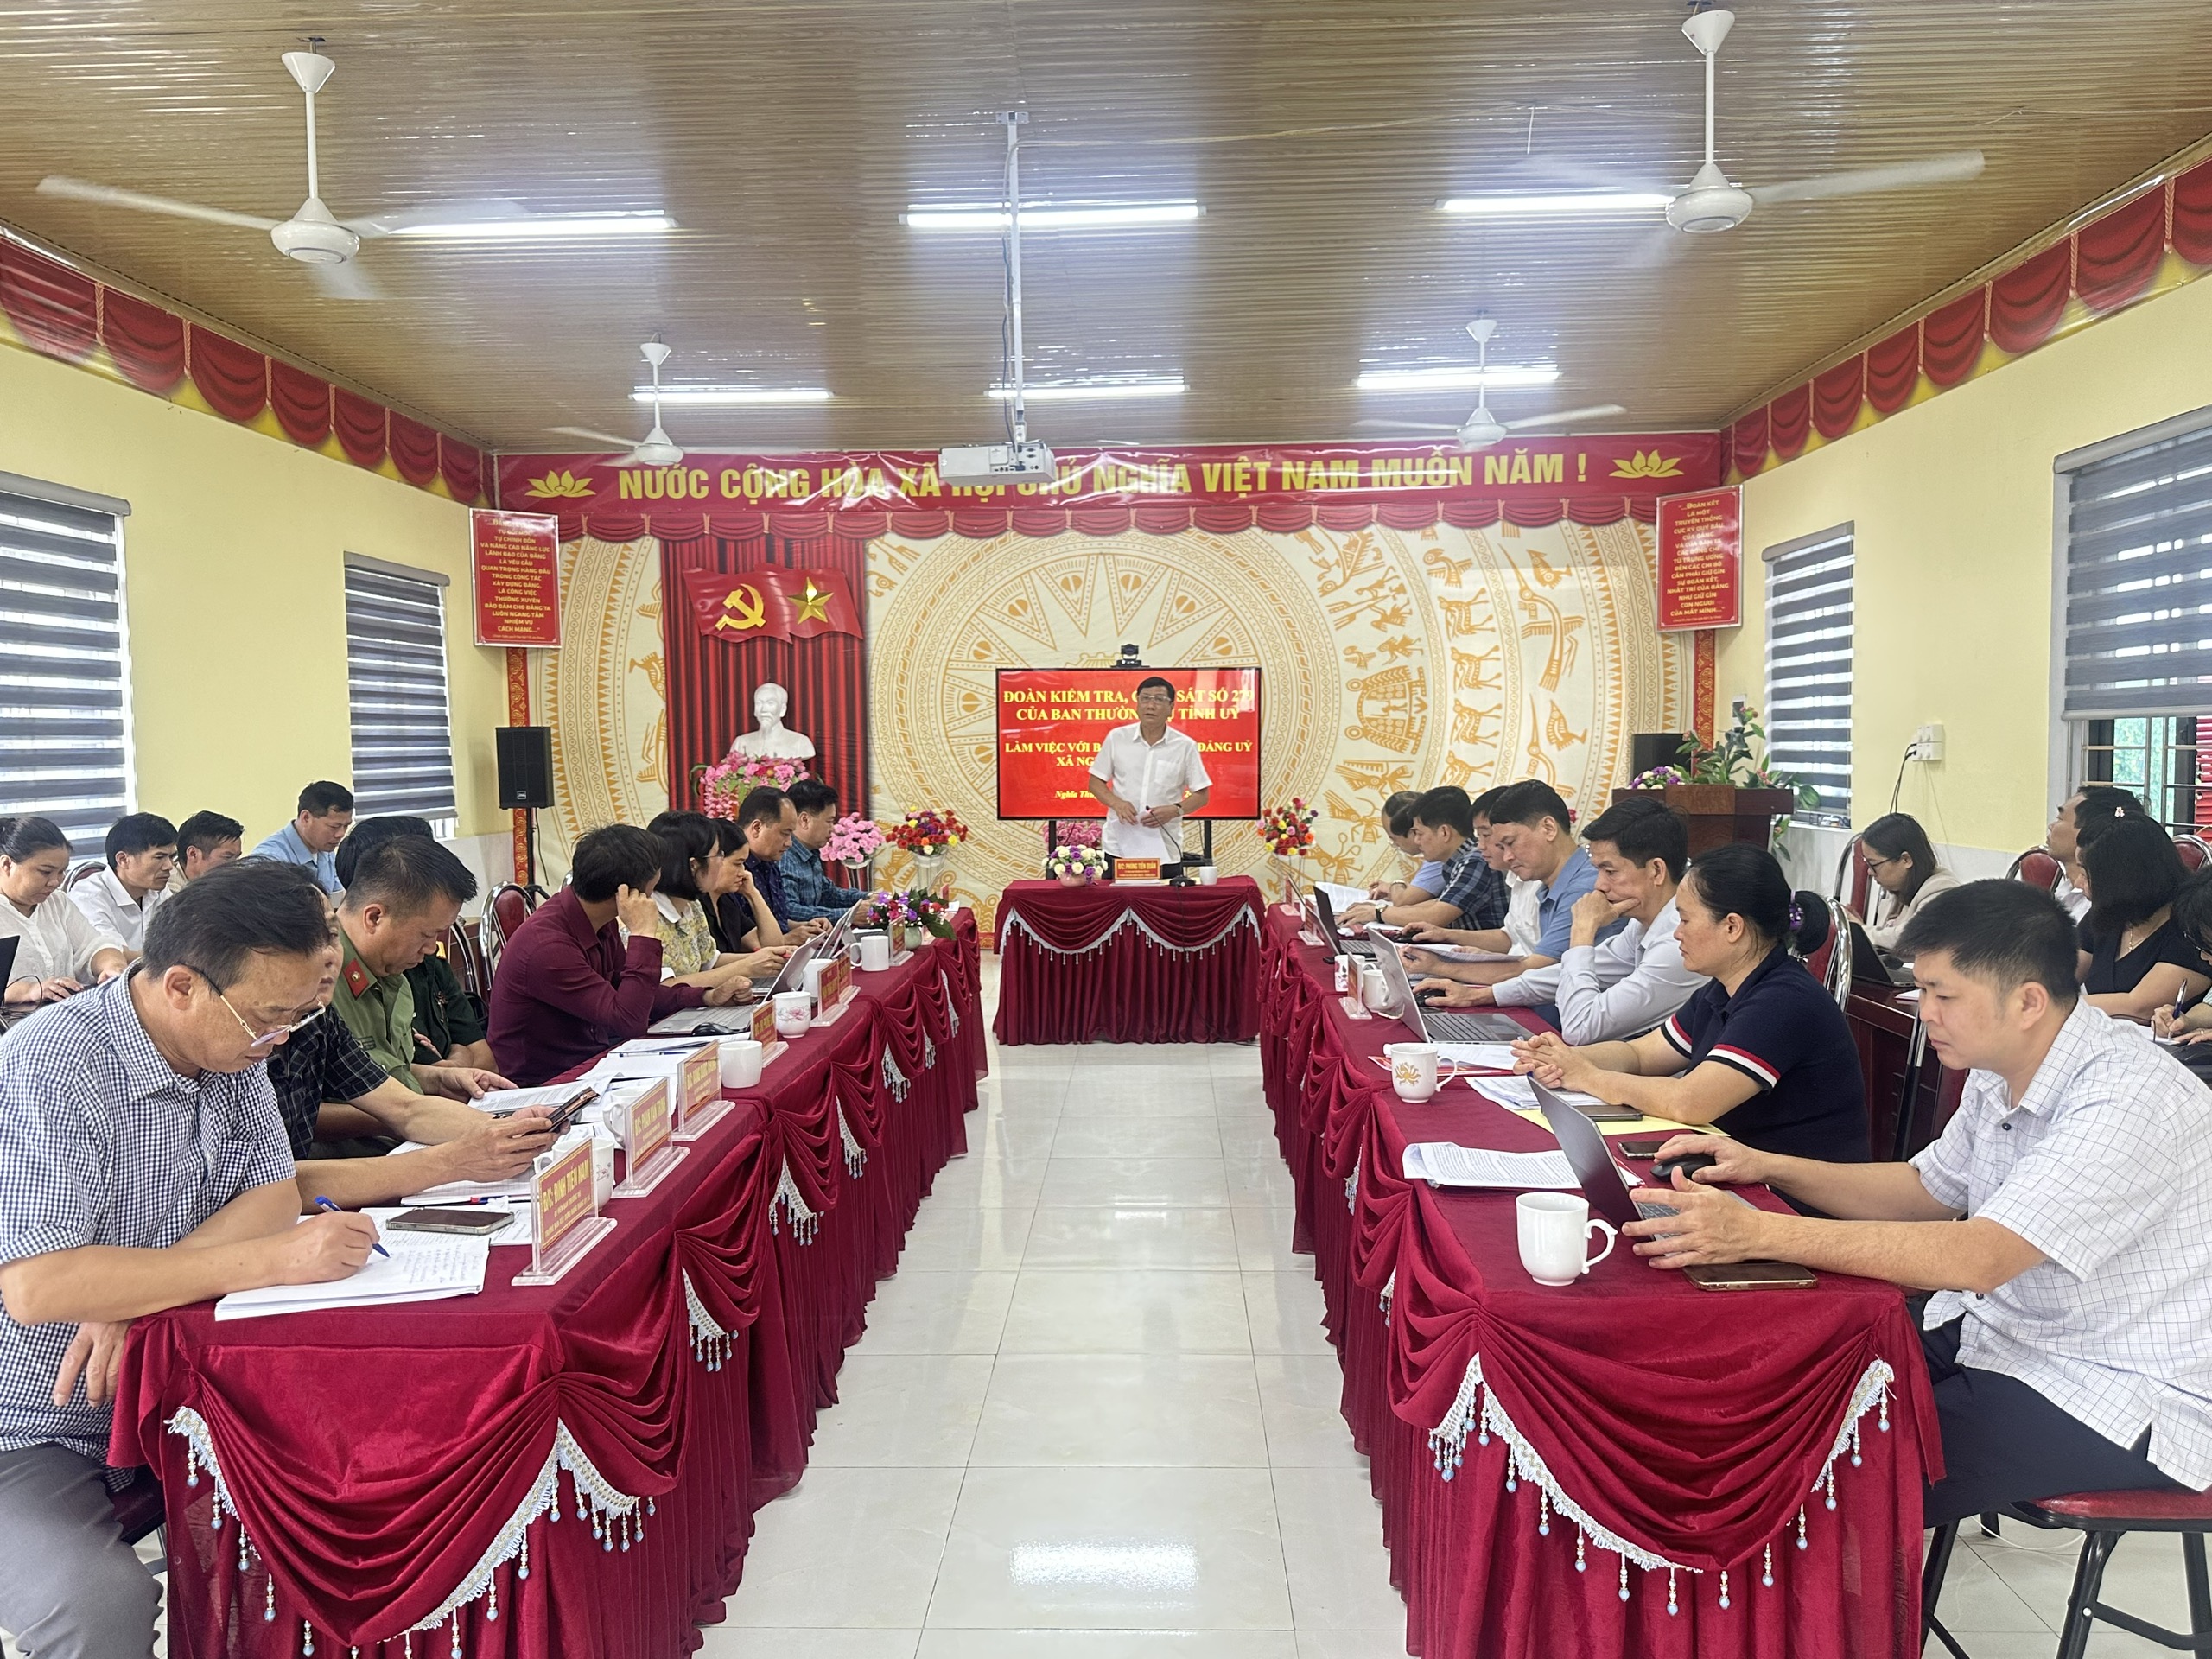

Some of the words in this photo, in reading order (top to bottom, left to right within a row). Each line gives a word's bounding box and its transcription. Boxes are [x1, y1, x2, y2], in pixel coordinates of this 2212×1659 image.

[618, 463, 709, 499] NƯỚC
[720, 462, 810, 505] CỘNG
[821, 461, 887, 499] HÒA
[899, 461, 942, 497] XÃ
[1093, 457, 1192, 493] NGHĨA
[1201, 456, 1272, 498] VIỆT
[1281, 460, 1359, 491] NAM
[1371, 449, 1473, 489] MUÔN
[1484, 448, 1564, 485] NĂM
[1577, 454, 1587, 483] !
[1003, 688, 1046, 703] ĐOÀN
[1050, 688, 1090, 702] KIỂM
[1093, 690, 1128, 704] TRA,
[1176, 687, 1206, 702] SÁT
[1207, 687, 1229, 702] SỐ
[1016, 706, 1049, 721] CỦA
[1051, 709, 1082, 720] BAN
[1084, 706, 1140, 721] THƯỜN
[1178, 706, 1216, 720] TỈNH
[1005, 741, 1033, 753] LÀM
[1034, 741, 1065, 754] VIỆC
[1067, 741, 1090, 753] VỚI
[1197, 740, 1233, 752] ĐẢNG
[1235, 740, 1253, 752] UỶ
[1056, 755, 1074, 766] XÃ
